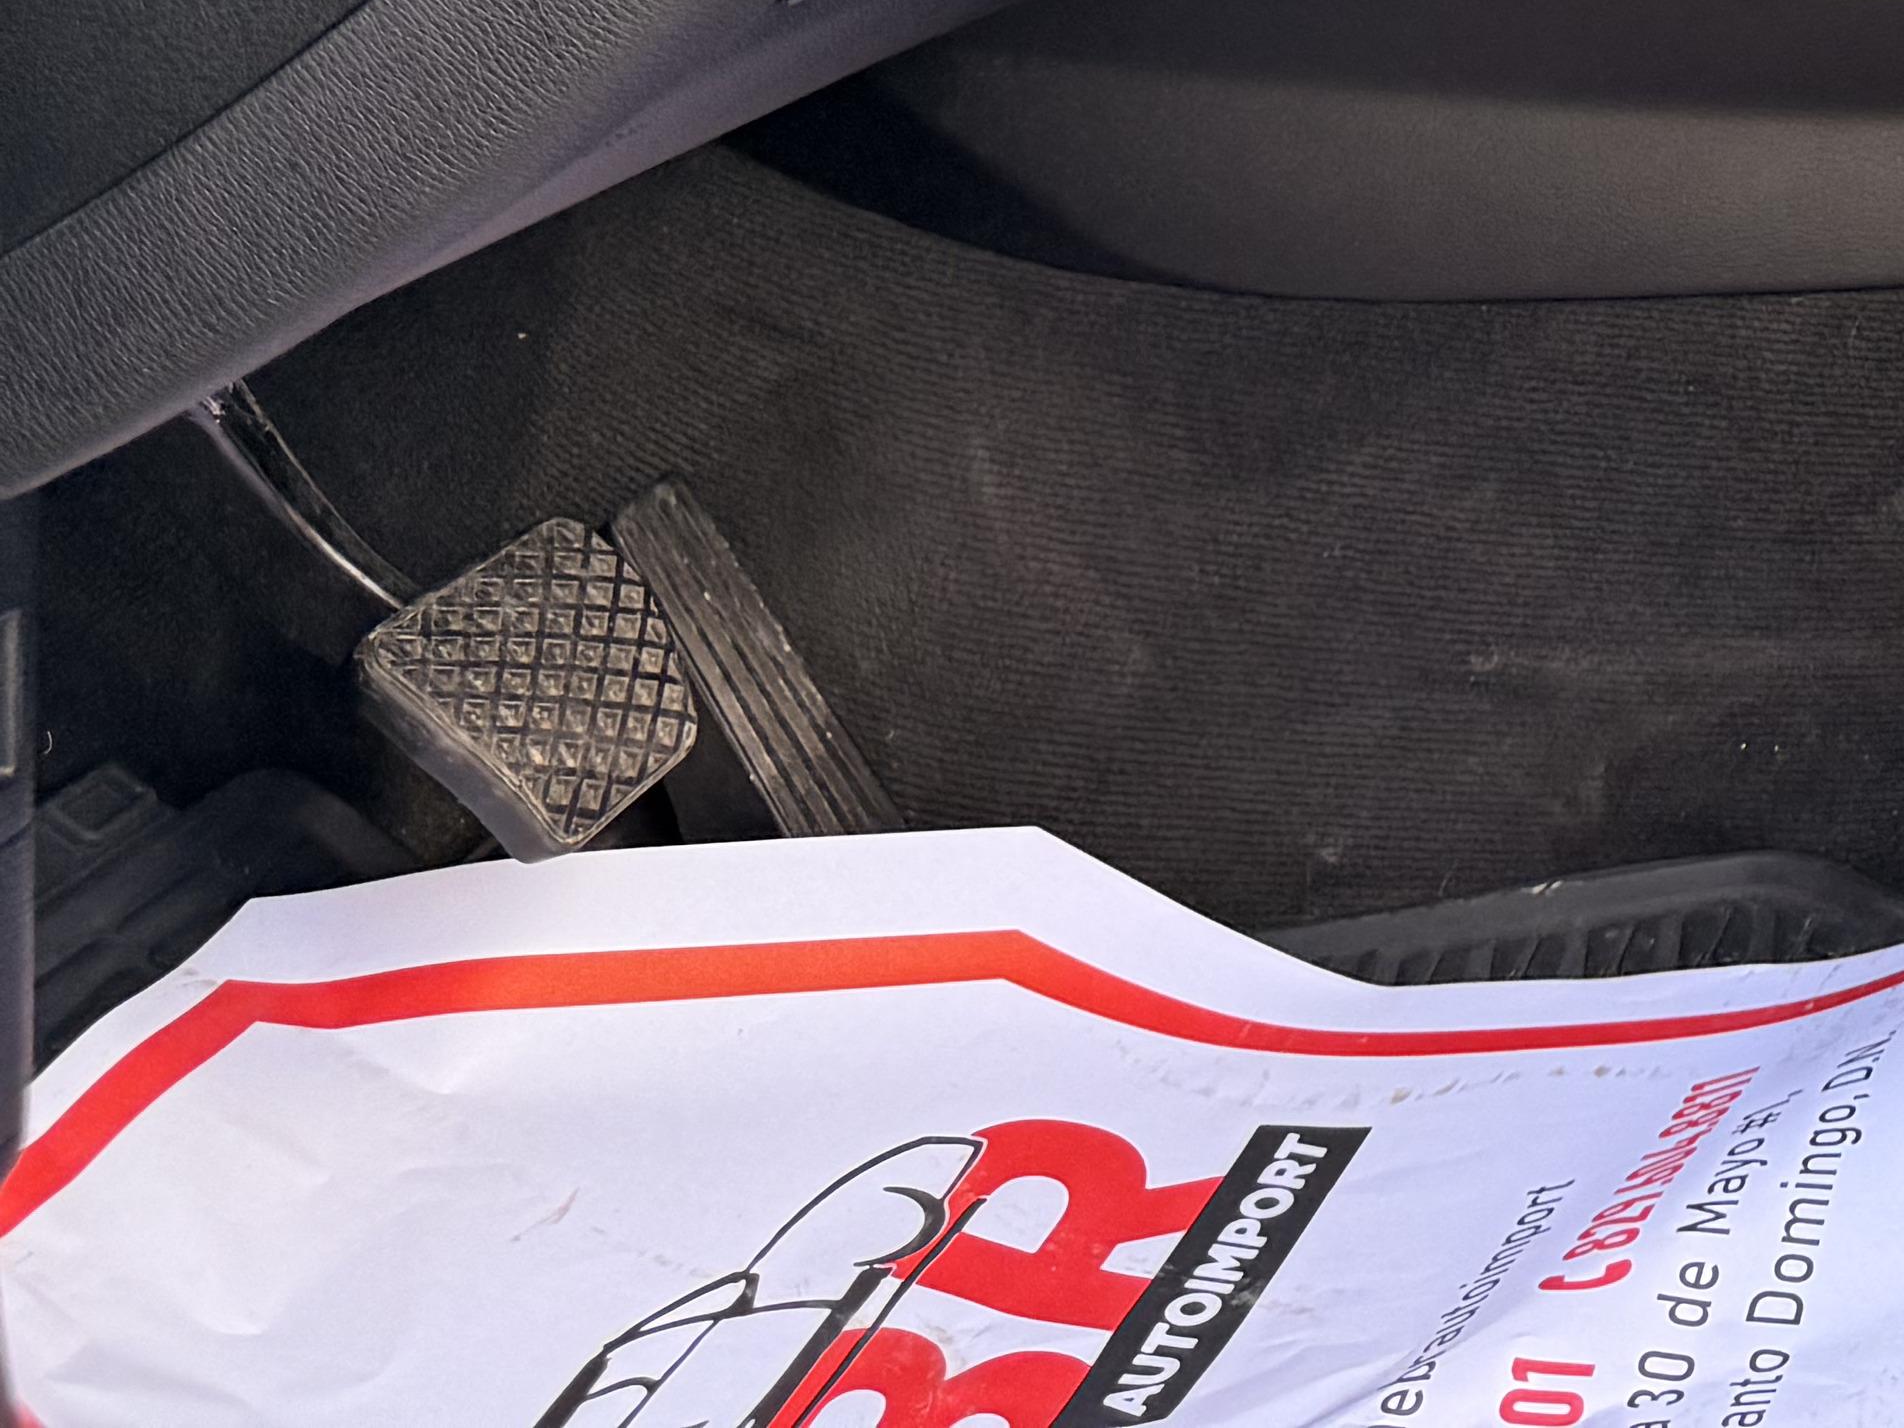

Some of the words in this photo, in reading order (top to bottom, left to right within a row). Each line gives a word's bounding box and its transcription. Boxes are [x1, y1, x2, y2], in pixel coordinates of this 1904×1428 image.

[1821, 1029, 1899, 1093] D.N.
[1562, 1065, 1762, 1262] 829.604.8811
[1676, 1140, 1769, 1235] Mayo
[1745, 1094, 1872, 1327] Domingo,
[1103, 1132, 1329, 1417] AUTOIMPORT
[1369, 1178, 1576, 1428] ebrautoimport
[1655, 1260, 1721, 1328] de
[1626, 1350, 1696, 1410] 30
[1721, 1349, 1791, 1428] anto
